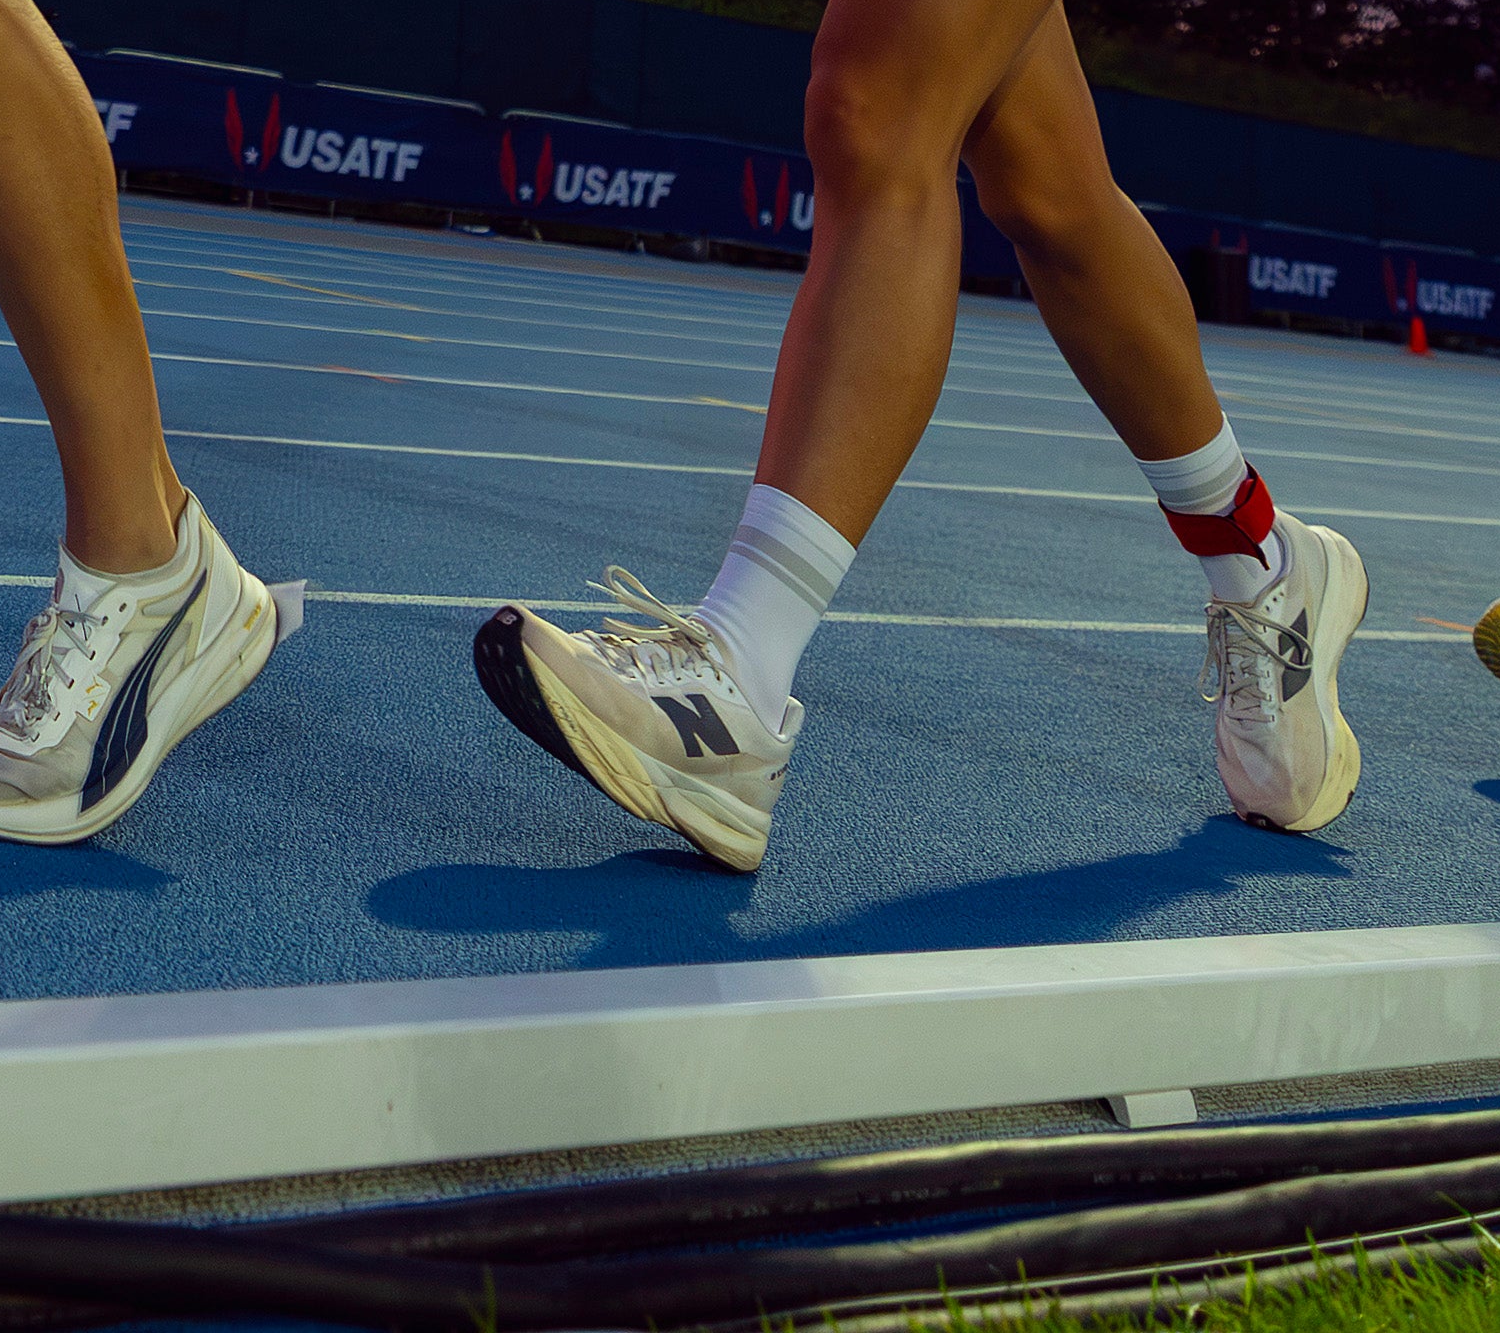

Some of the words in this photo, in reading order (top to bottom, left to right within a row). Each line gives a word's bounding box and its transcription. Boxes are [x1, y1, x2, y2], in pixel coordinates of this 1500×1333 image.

[279, 125, 424, 182] USATF
[553, 162, 677, 209] USATF
[1248, 255, 1338, 299] USATF
[1417, 279, 1497, 319] USATF
